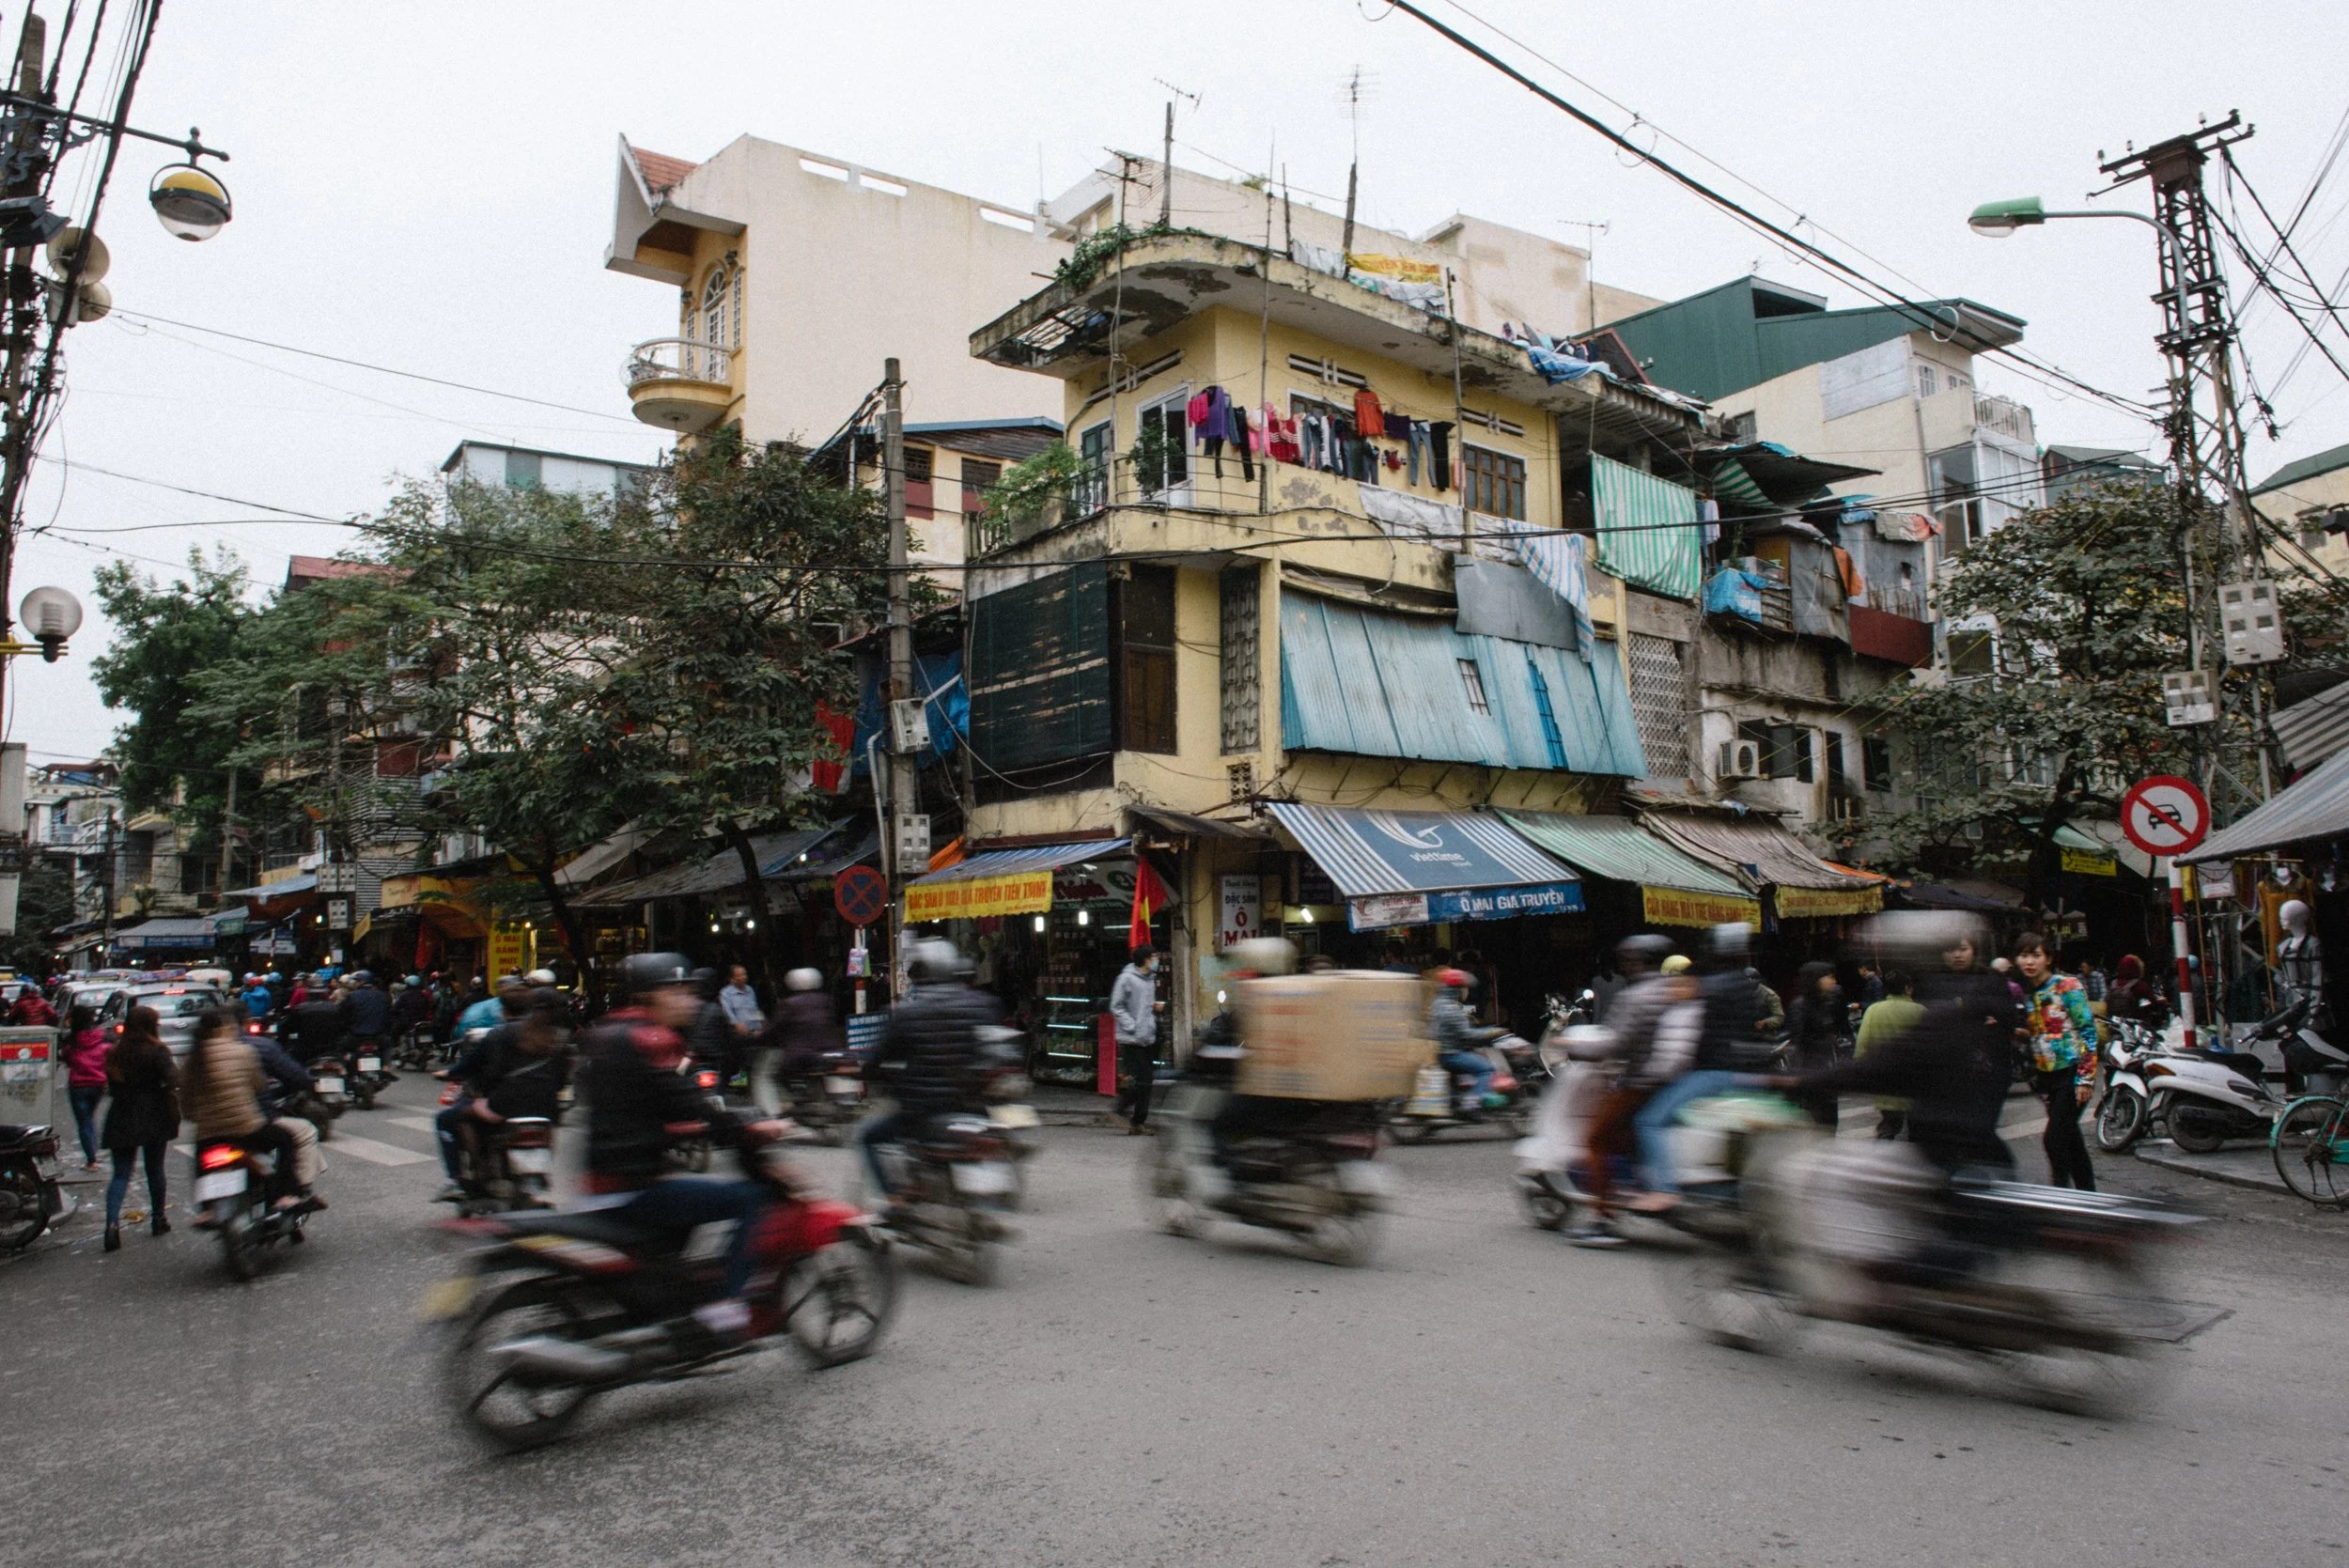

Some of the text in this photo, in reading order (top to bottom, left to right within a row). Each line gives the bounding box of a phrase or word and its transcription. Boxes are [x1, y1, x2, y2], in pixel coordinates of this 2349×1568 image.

[1472, 897, 1494, 911] MAI
[1497, 894, 1518, 909] GIA
[1519, 888, 1564, 907] TRUYỀN
[1235, 906, 1248, 927] Ô
